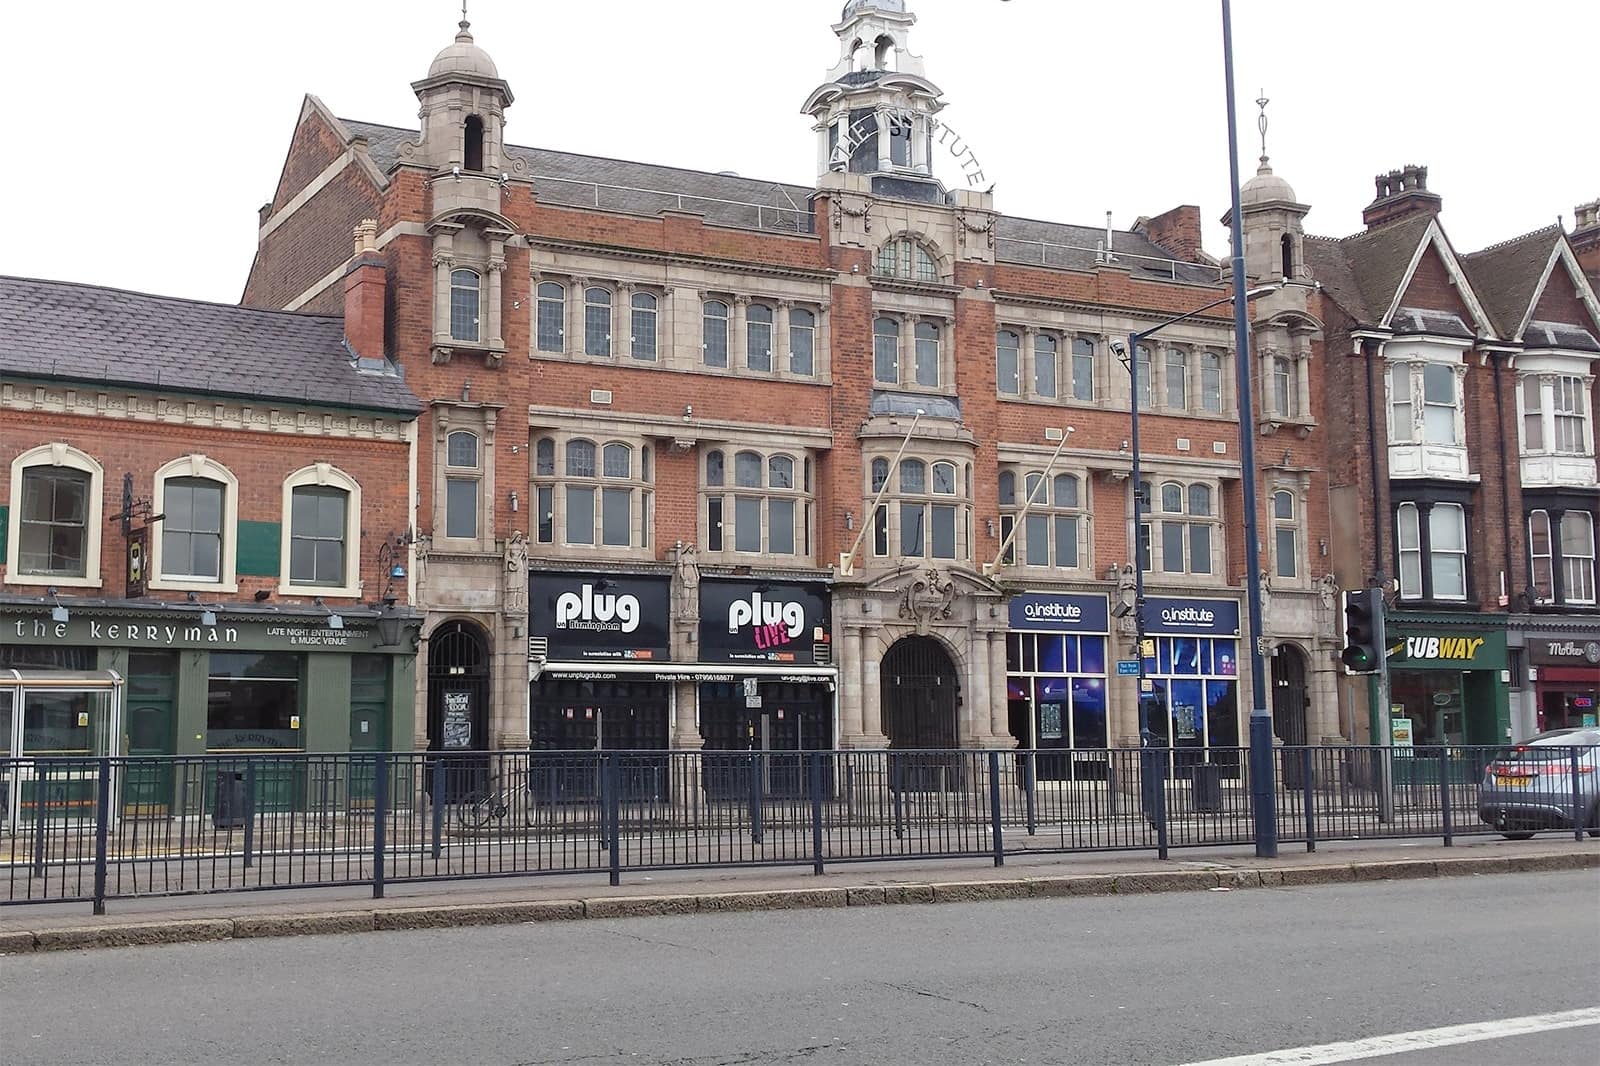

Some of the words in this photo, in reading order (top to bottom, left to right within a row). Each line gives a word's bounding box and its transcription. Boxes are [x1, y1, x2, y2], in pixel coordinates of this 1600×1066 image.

[556, 584, 640, 632] plug
[729, 592, 804, 638] plug
[267, 627, 285, 636] LATE
[287, 628, 309, 637] NIGHT
[311, 629, 369, 639] ENTERTAINMENT
[299, 637, 321, 645] MUSIC
[323, 637, 347, 646] VENUE
[754, 621, 791, 650] LIVE
[1407, 637, 1484, 659] SUBWAY
[1547, 641, 1585, 656] Mother
